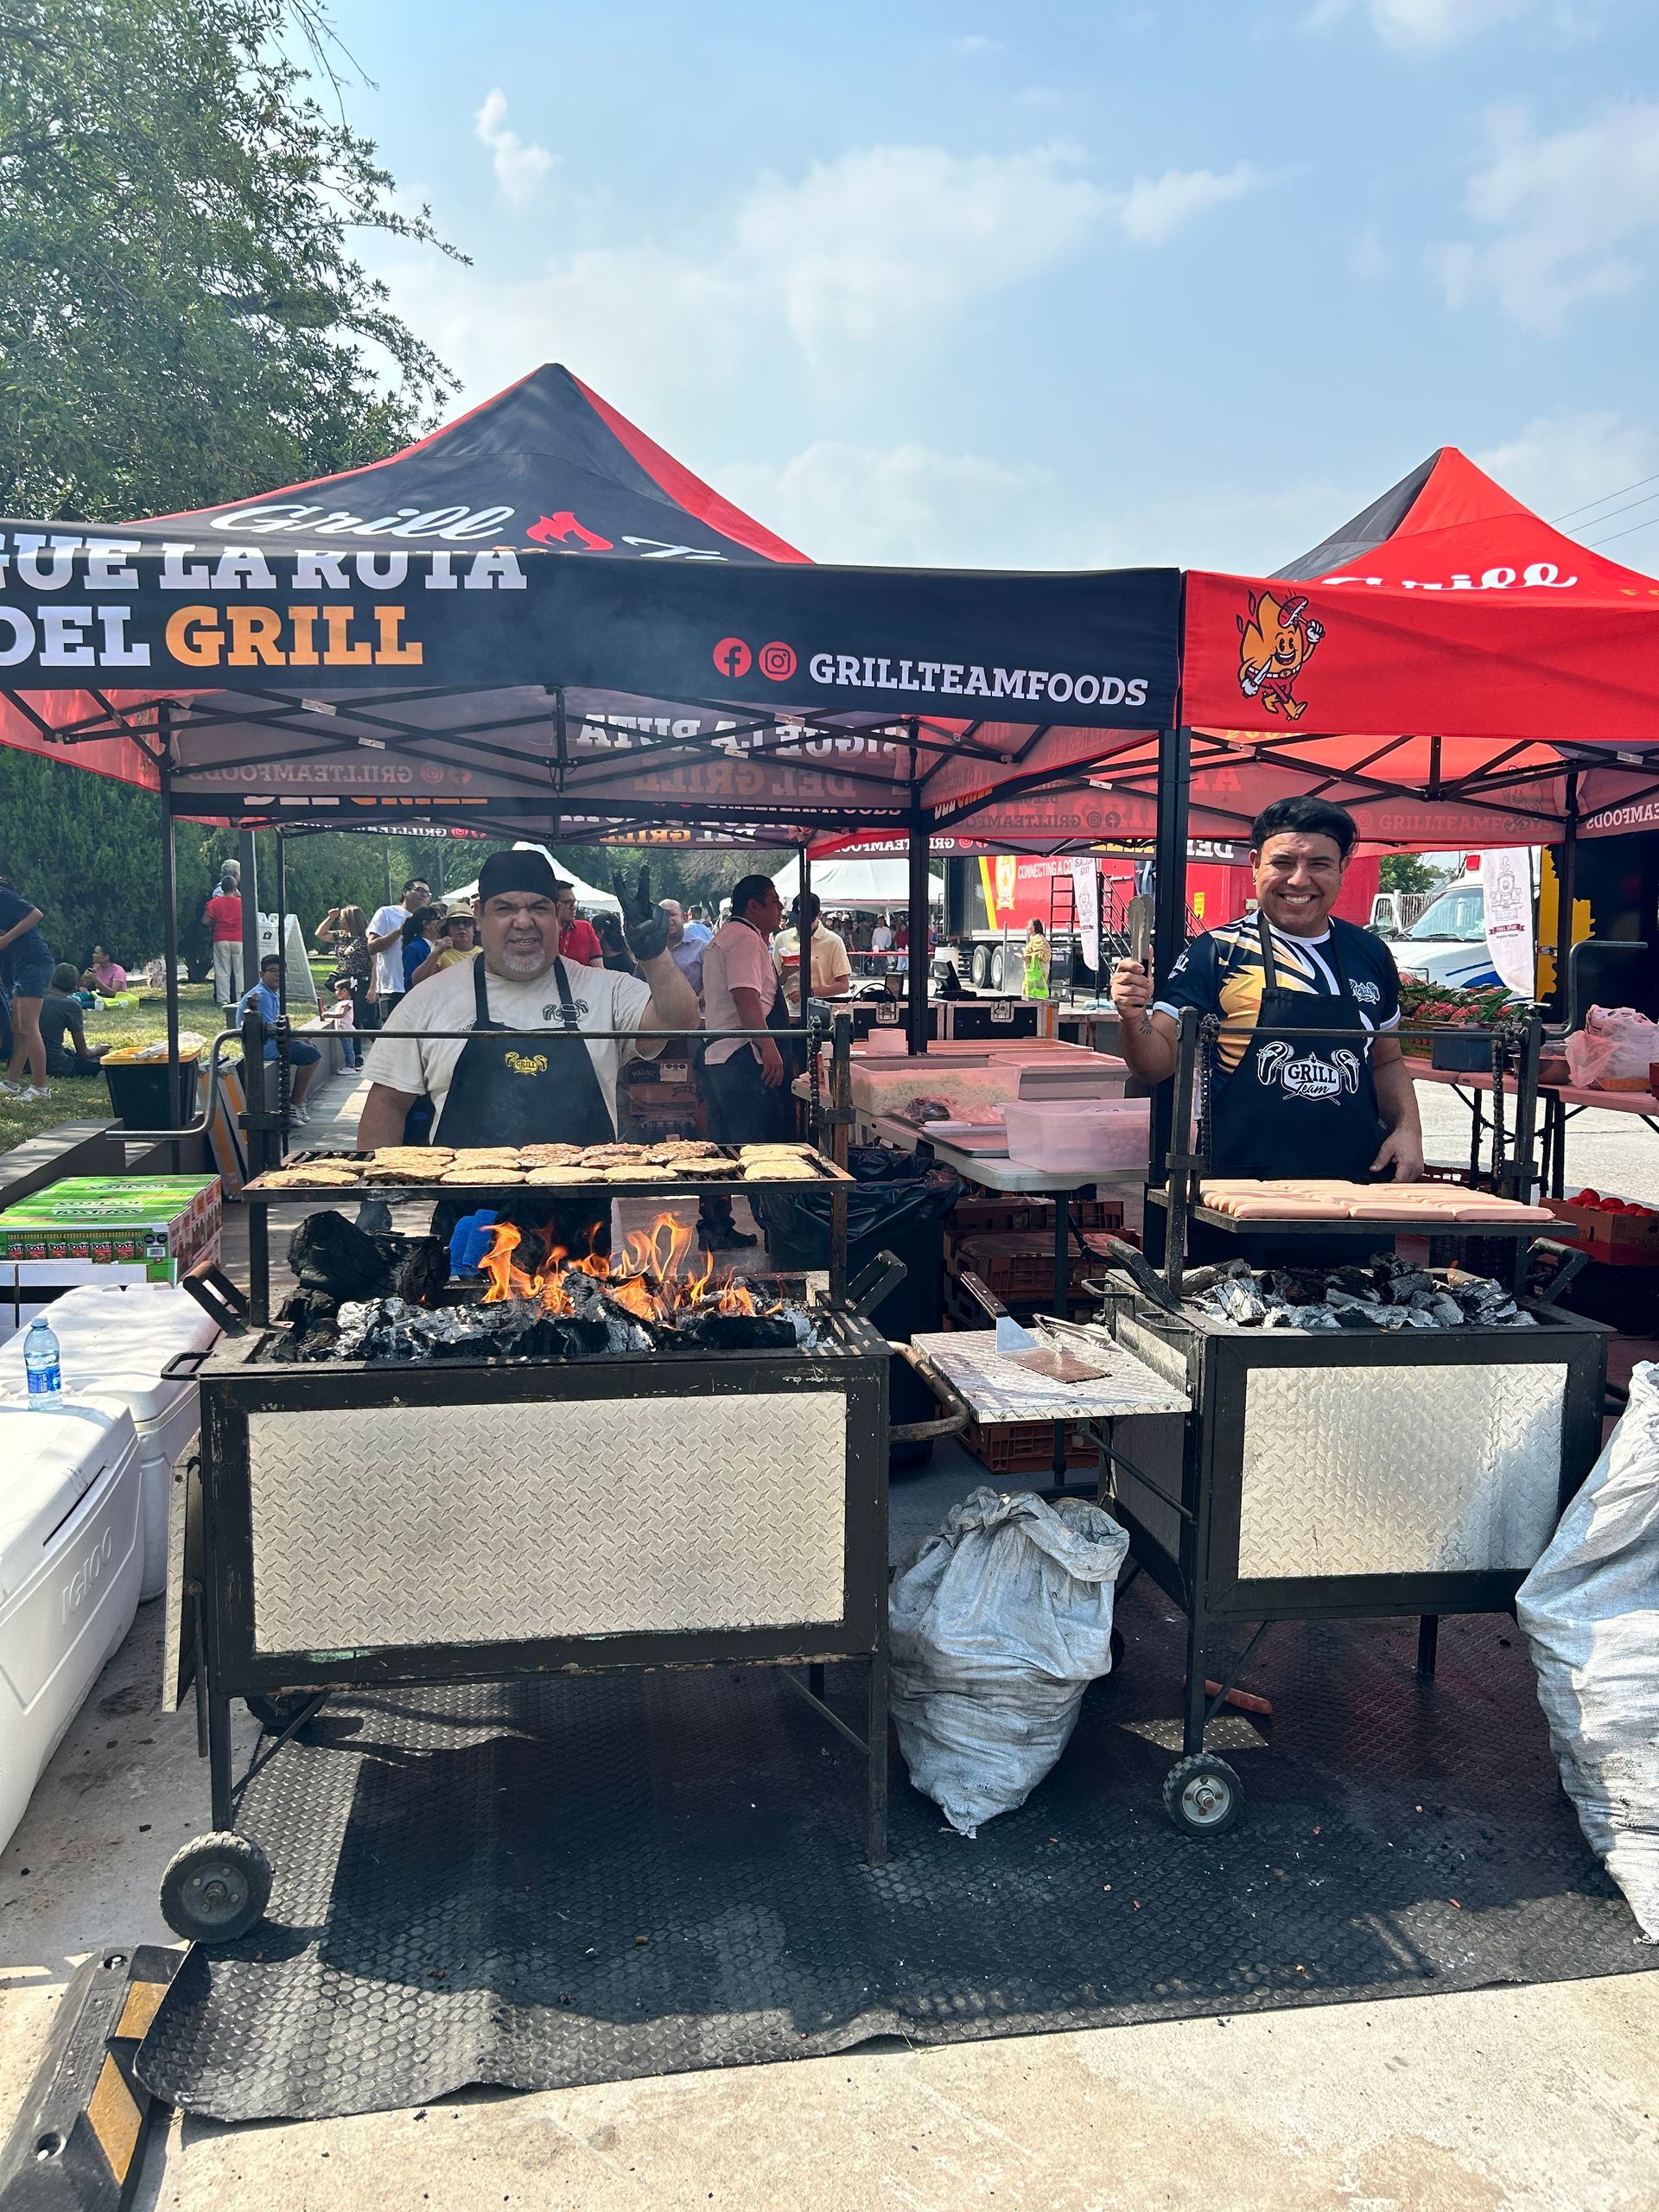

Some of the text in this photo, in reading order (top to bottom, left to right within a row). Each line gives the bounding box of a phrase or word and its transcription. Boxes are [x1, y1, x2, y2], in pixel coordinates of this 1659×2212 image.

[209, 504, 516, 541] Grill
[0, 533, 142, 591] UE
[159, 542, 276, 589] LA
[165, 605, 423, 666] GRILL
[809, 652, 1149, 708] GRILLTEAMFOODS
[1018, 861, 1057, 880] CONNECTING
[516, 1060, 537, 1070] GRILL
[1287, 1064, 1337, 1084] GRILL
[1295, 1080, 1331, 1095] Team
[62, 1525, 111, 1625] IGLOO
